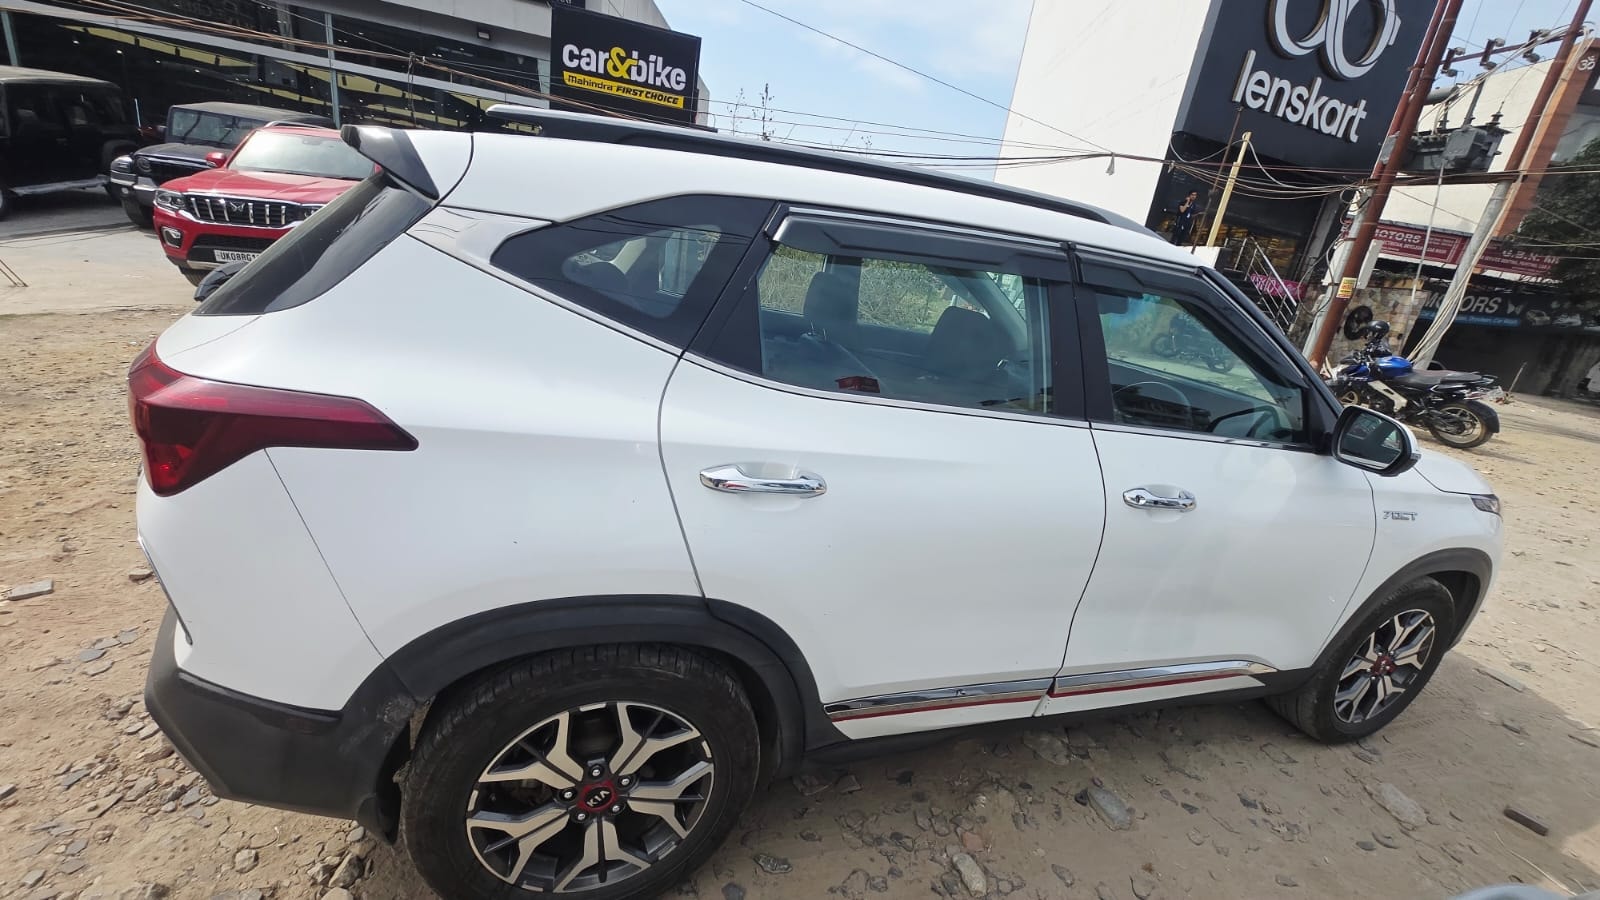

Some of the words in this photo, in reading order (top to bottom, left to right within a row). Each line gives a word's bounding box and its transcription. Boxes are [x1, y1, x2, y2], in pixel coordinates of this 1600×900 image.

[562, 44, 687, 91] car&bike
[567, 75, 613, 92] Mahindra
[615, 86, 645, 98] FIRST
[645, 91, 680, 105] CHOICE
[1232, 49, 1367, 143] lenskart
[586, 790, 610, 807] KIA
